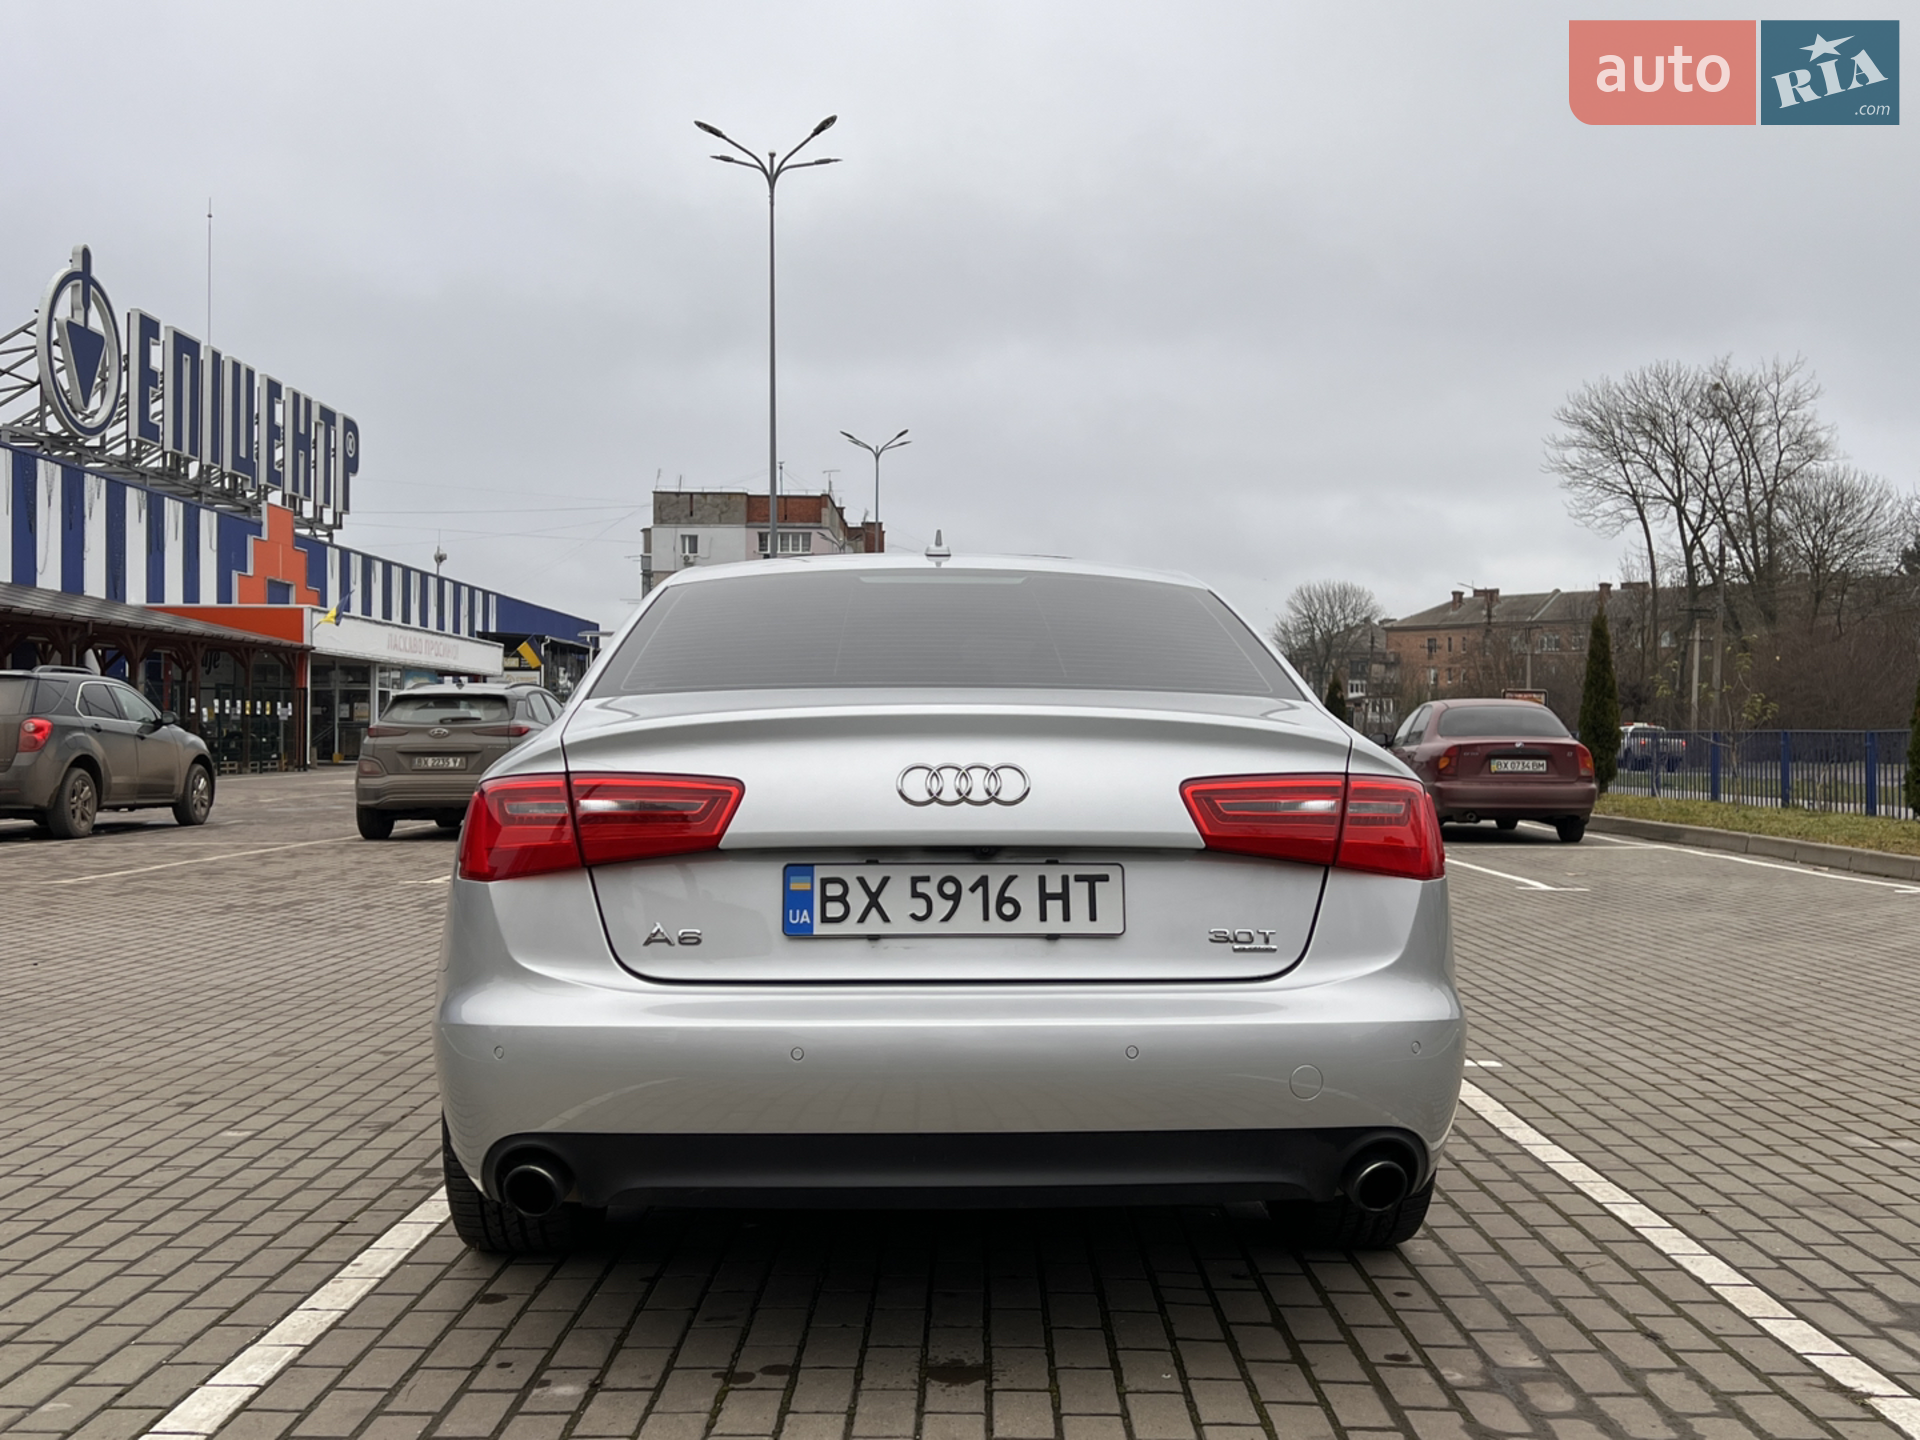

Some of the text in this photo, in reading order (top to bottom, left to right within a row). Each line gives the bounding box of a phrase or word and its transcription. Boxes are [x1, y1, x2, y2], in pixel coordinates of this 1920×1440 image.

[128, 308, 360, 515] ЕПІЦЕНТР
[789, 909, 811, 924] UA
[820, 874, 1110, 924] BX 5916 HT
[642, 922, 702, 946] A6
